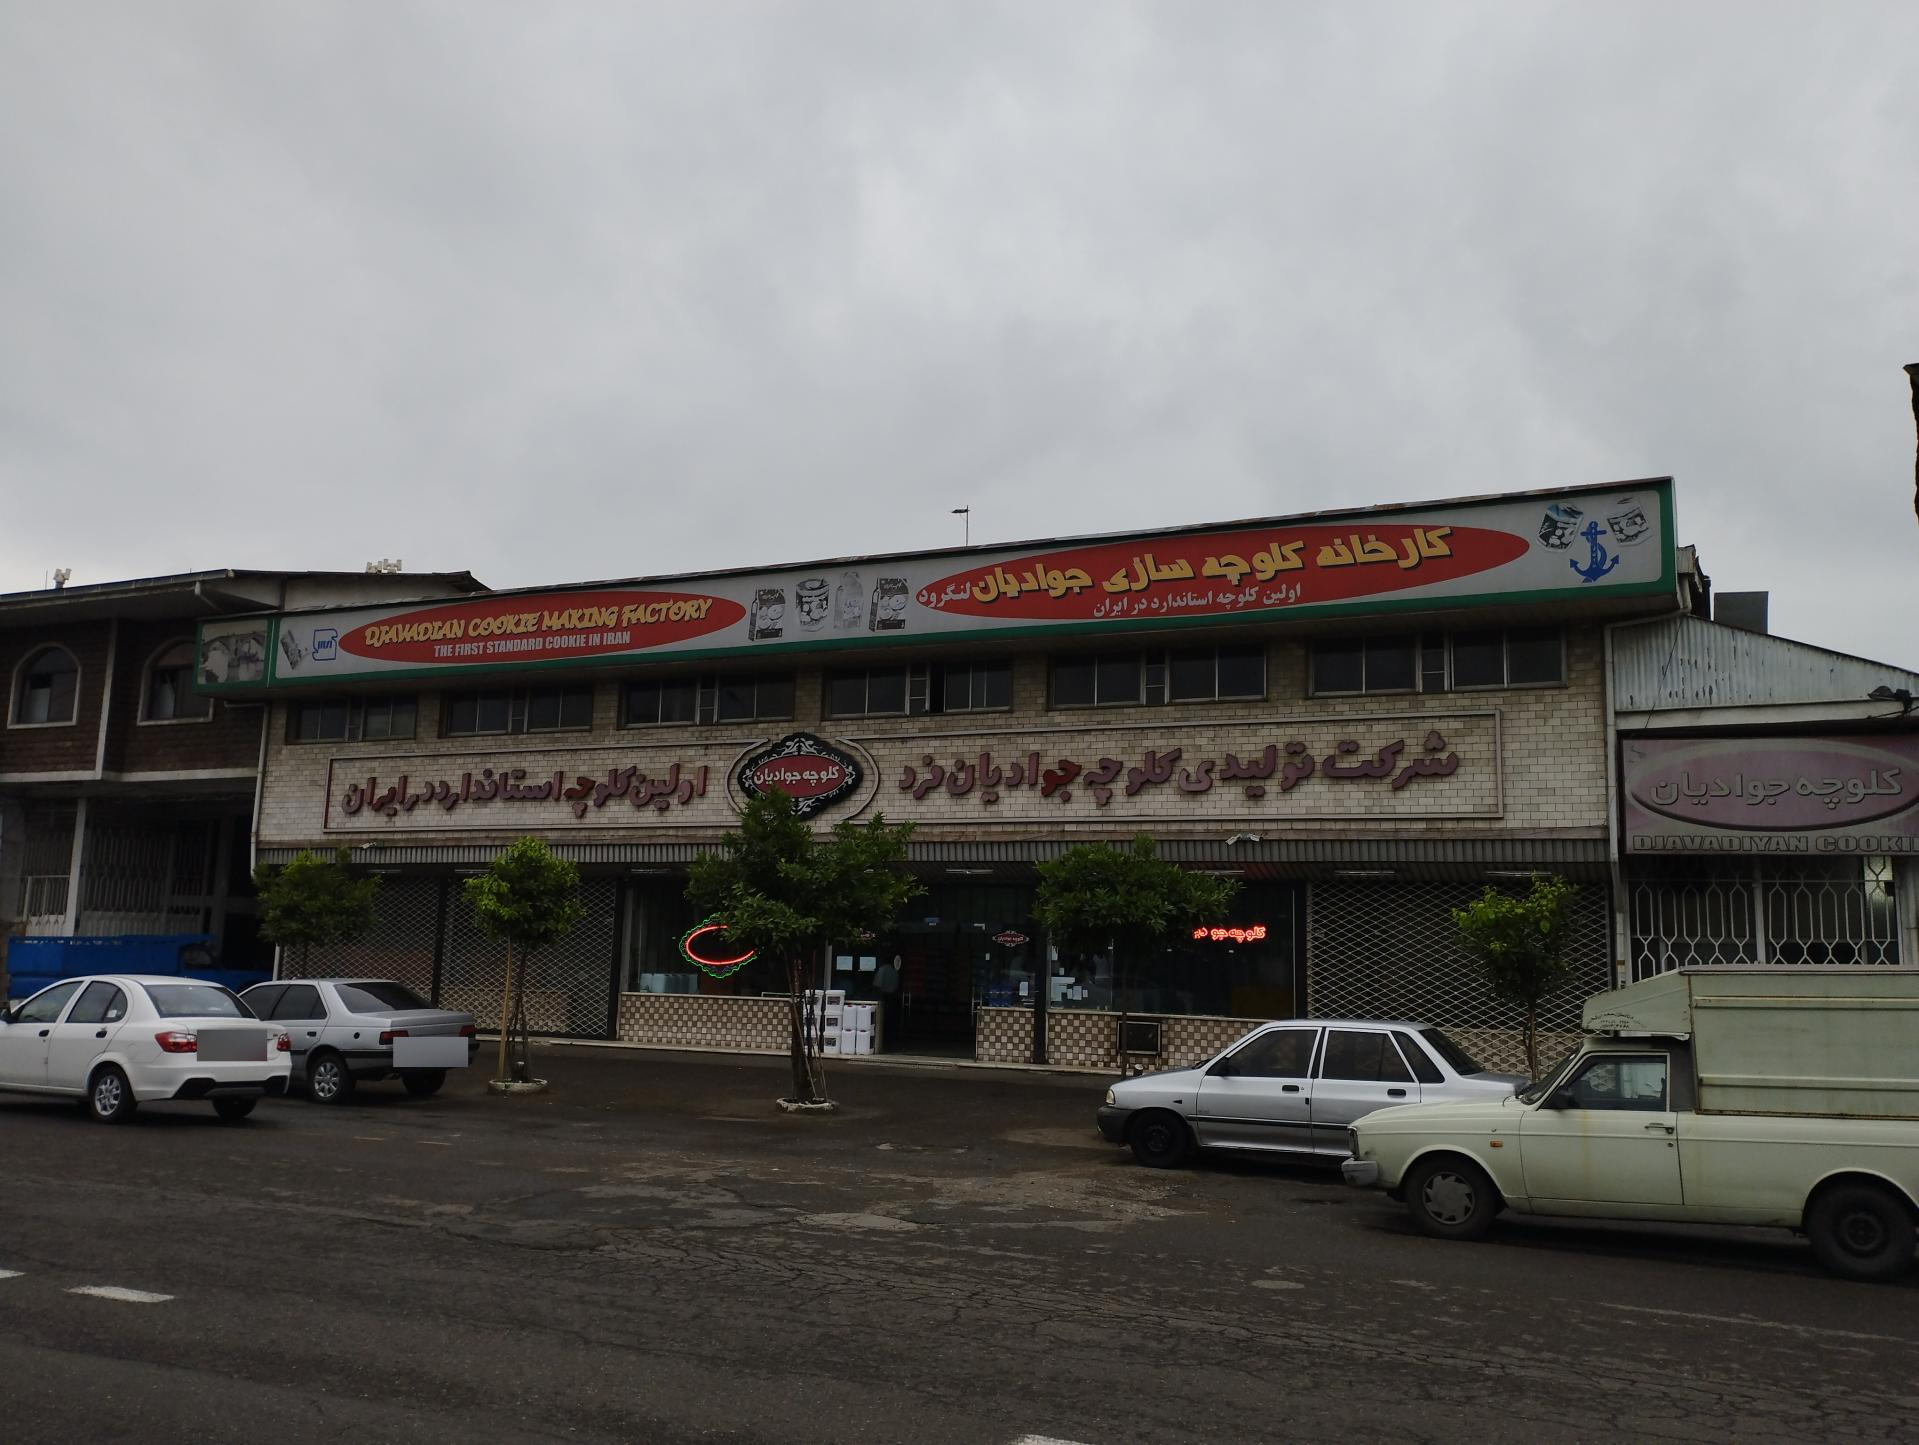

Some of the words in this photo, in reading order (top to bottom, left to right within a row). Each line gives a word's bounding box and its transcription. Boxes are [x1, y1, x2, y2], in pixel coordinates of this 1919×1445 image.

[1201, 540, 1306, 586] کلوچه
[1316, 526, 1453, 570] کارخانه
[971, 563, 1093, 603] جوادیان
[1102, 553, 1195, 593] سازی
[1263, 581, 1301, 605] اولین
[918, 581, 972, 608] لنگرود
[1093, 596, 1128, 617] ایران
[1130, 597, 1147, 615] در
[1150, 590, 1213, 613] استاندارد
[1216, 586, 1259, 610] کلوچه
[364, 618, 466, 648] DJAVADIAN
[468, 610, 542, 638] COOKIE
[541, 605, 619, 631] MAKING
[621, 598, 713, 629] FACTORY
[434, 644, 454, 658] THE
[455, 642, 485, 657] FIRST
[486, 637, 543, 654] STANDARD
[545, 634, 587, 649] COOKIE
[588, 633, 601, 647] IN
[603, 631, 631, 646] IRAN
[753, 767, 802, 785] جوادیان
[802, 765, 840, 786] کلوچه
[898, 754, 945, 800] فرد
[946, 752, 1083, 803] جوادیان
[1083, 747, 1182, 806] کلوچه
[1178, 741, 1316, 797] تولیدی
[1322, 730, 1459, 790] شرکت
[342, 775, 409, 817] ایران
[402, 781, 435, 811] در
[434, 768, 563, 811] استاندارد
[564, 765, 637, 819] کلوچه
[629, 763, 708, 810] اولین
[1649, 771, 1791, 806] جوادیان
[1795, 768, 1903, 810] کلوچه
